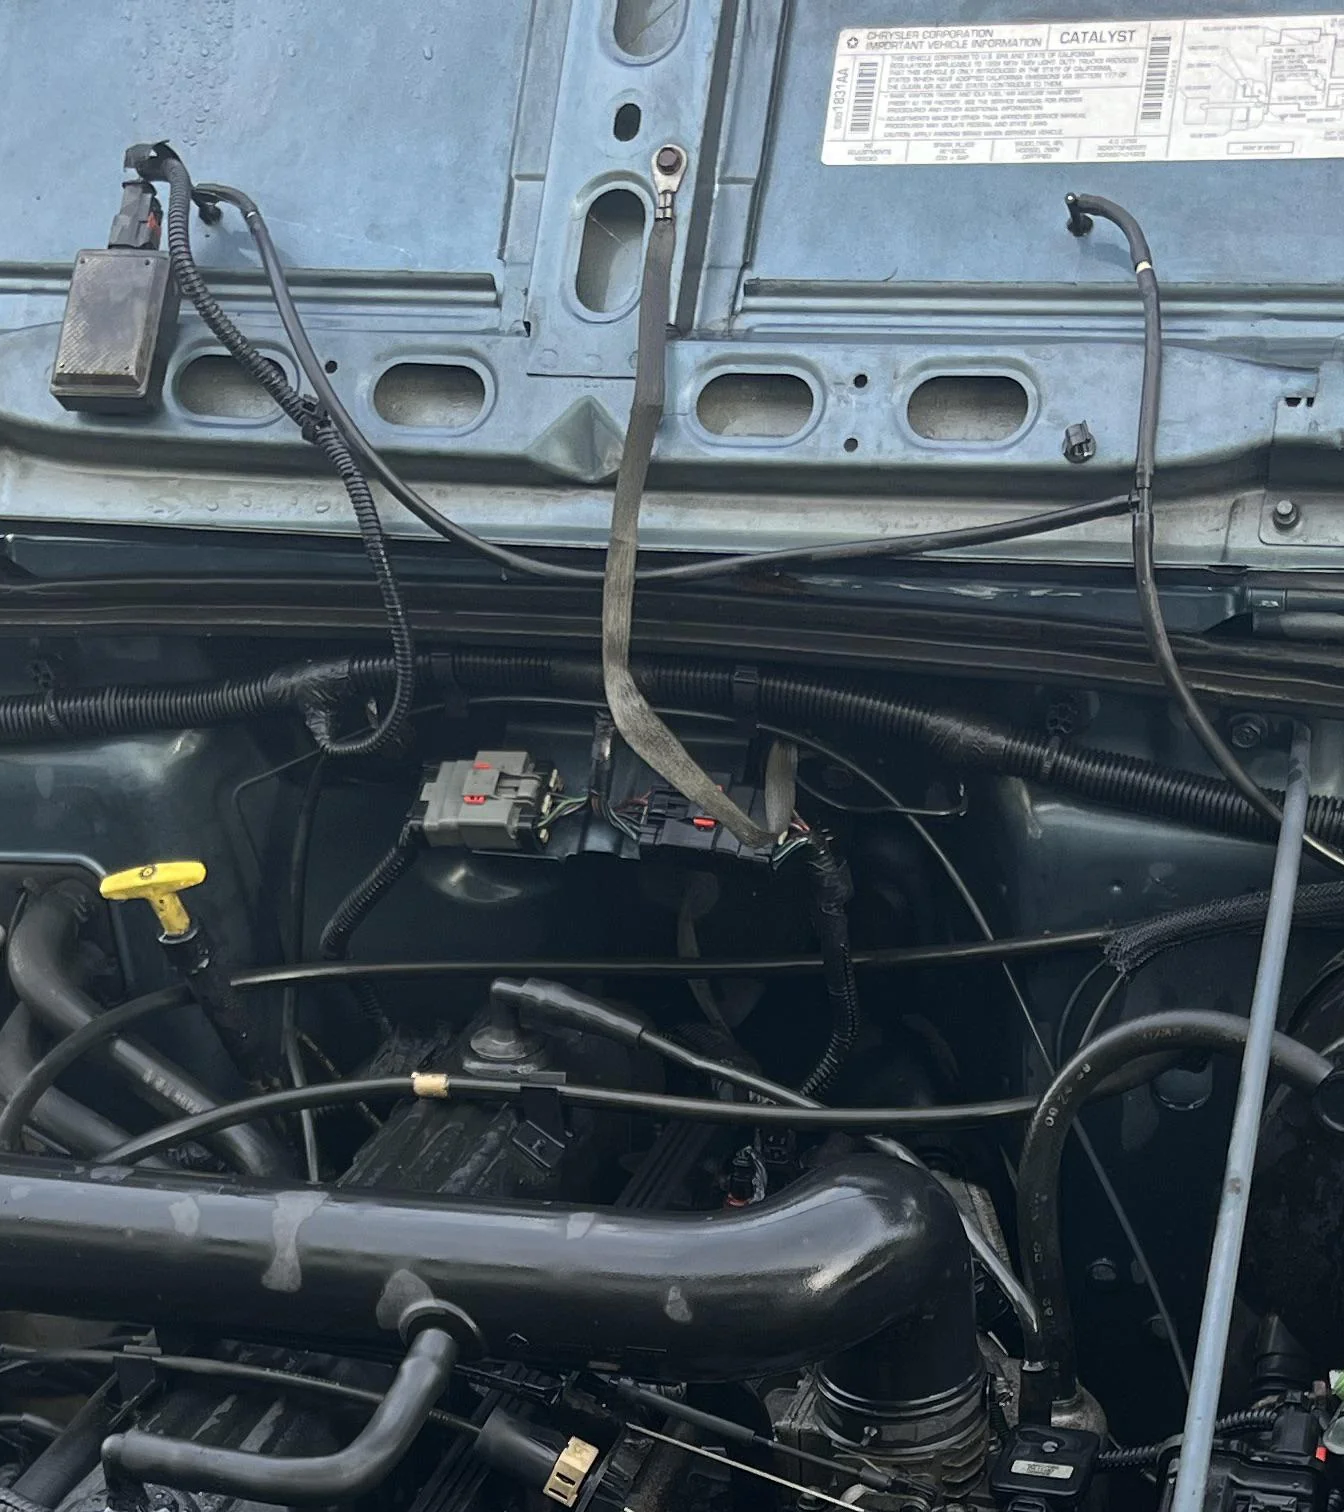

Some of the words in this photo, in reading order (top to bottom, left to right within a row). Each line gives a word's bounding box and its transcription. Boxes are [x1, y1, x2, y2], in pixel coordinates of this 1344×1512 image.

[866, 31, 919, 40] CHRYSLER
[922, 29, 994, 39] CORPORATION
[1059, 29, 1137, 44] CATALYST
[866, 40, 924, 50] IMPORTANT
[927, 39, 968, 49] VEHICLE
[970, 37, 1042, 48] INFORMATION
